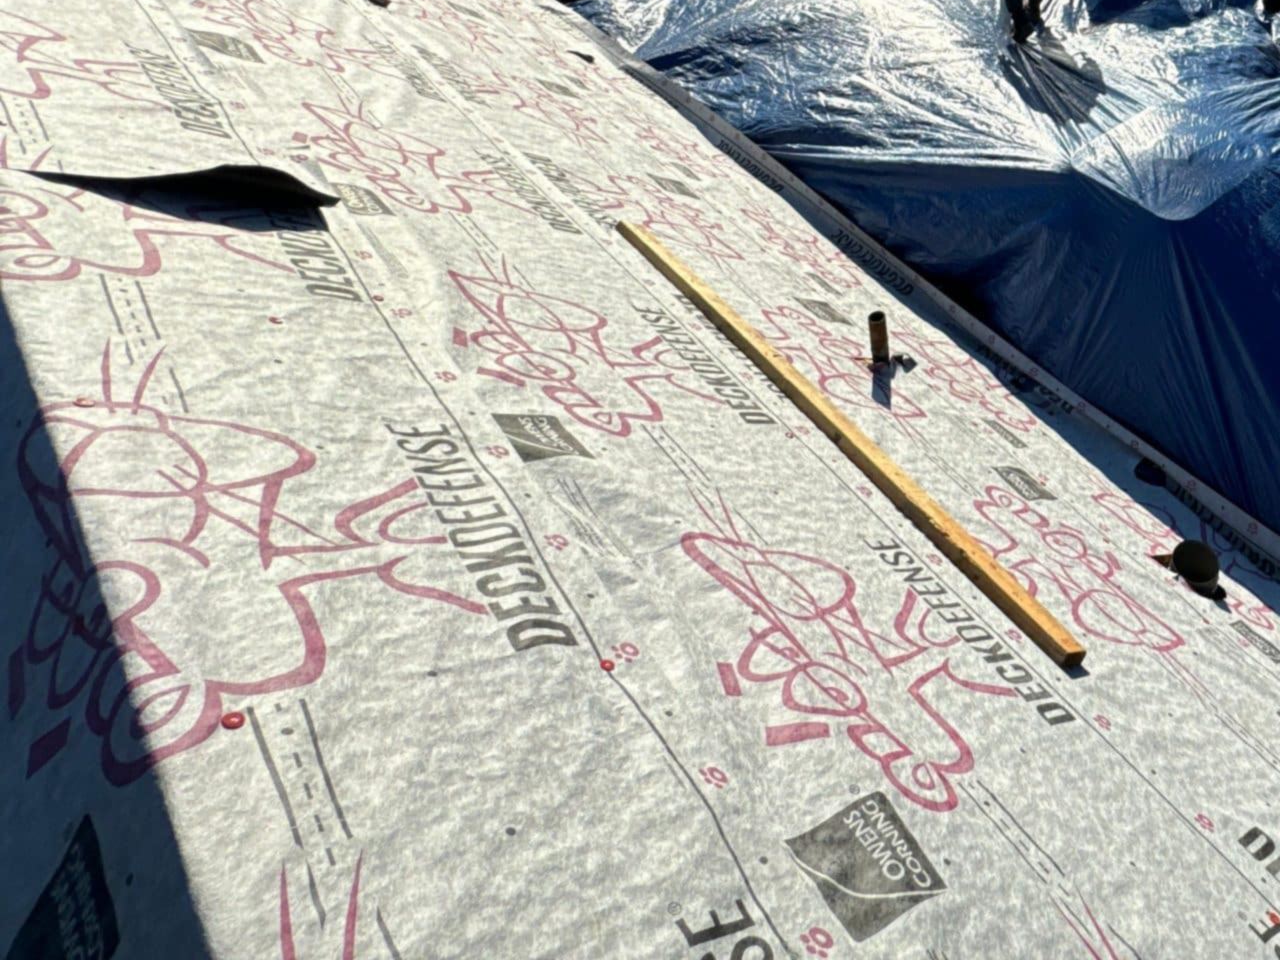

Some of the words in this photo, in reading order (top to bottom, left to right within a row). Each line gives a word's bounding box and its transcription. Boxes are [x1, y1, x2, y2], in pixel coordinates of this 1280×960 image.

[627, 295, 778, 425] DECKDEFENSE
[380, 417, 578, 652] DECKDEFENSE
[864, 538, 1076, 725] DECKDEFENSE
[843, 810, 905, 880] OWENS
[861, 800, 932, 888] CORNING
